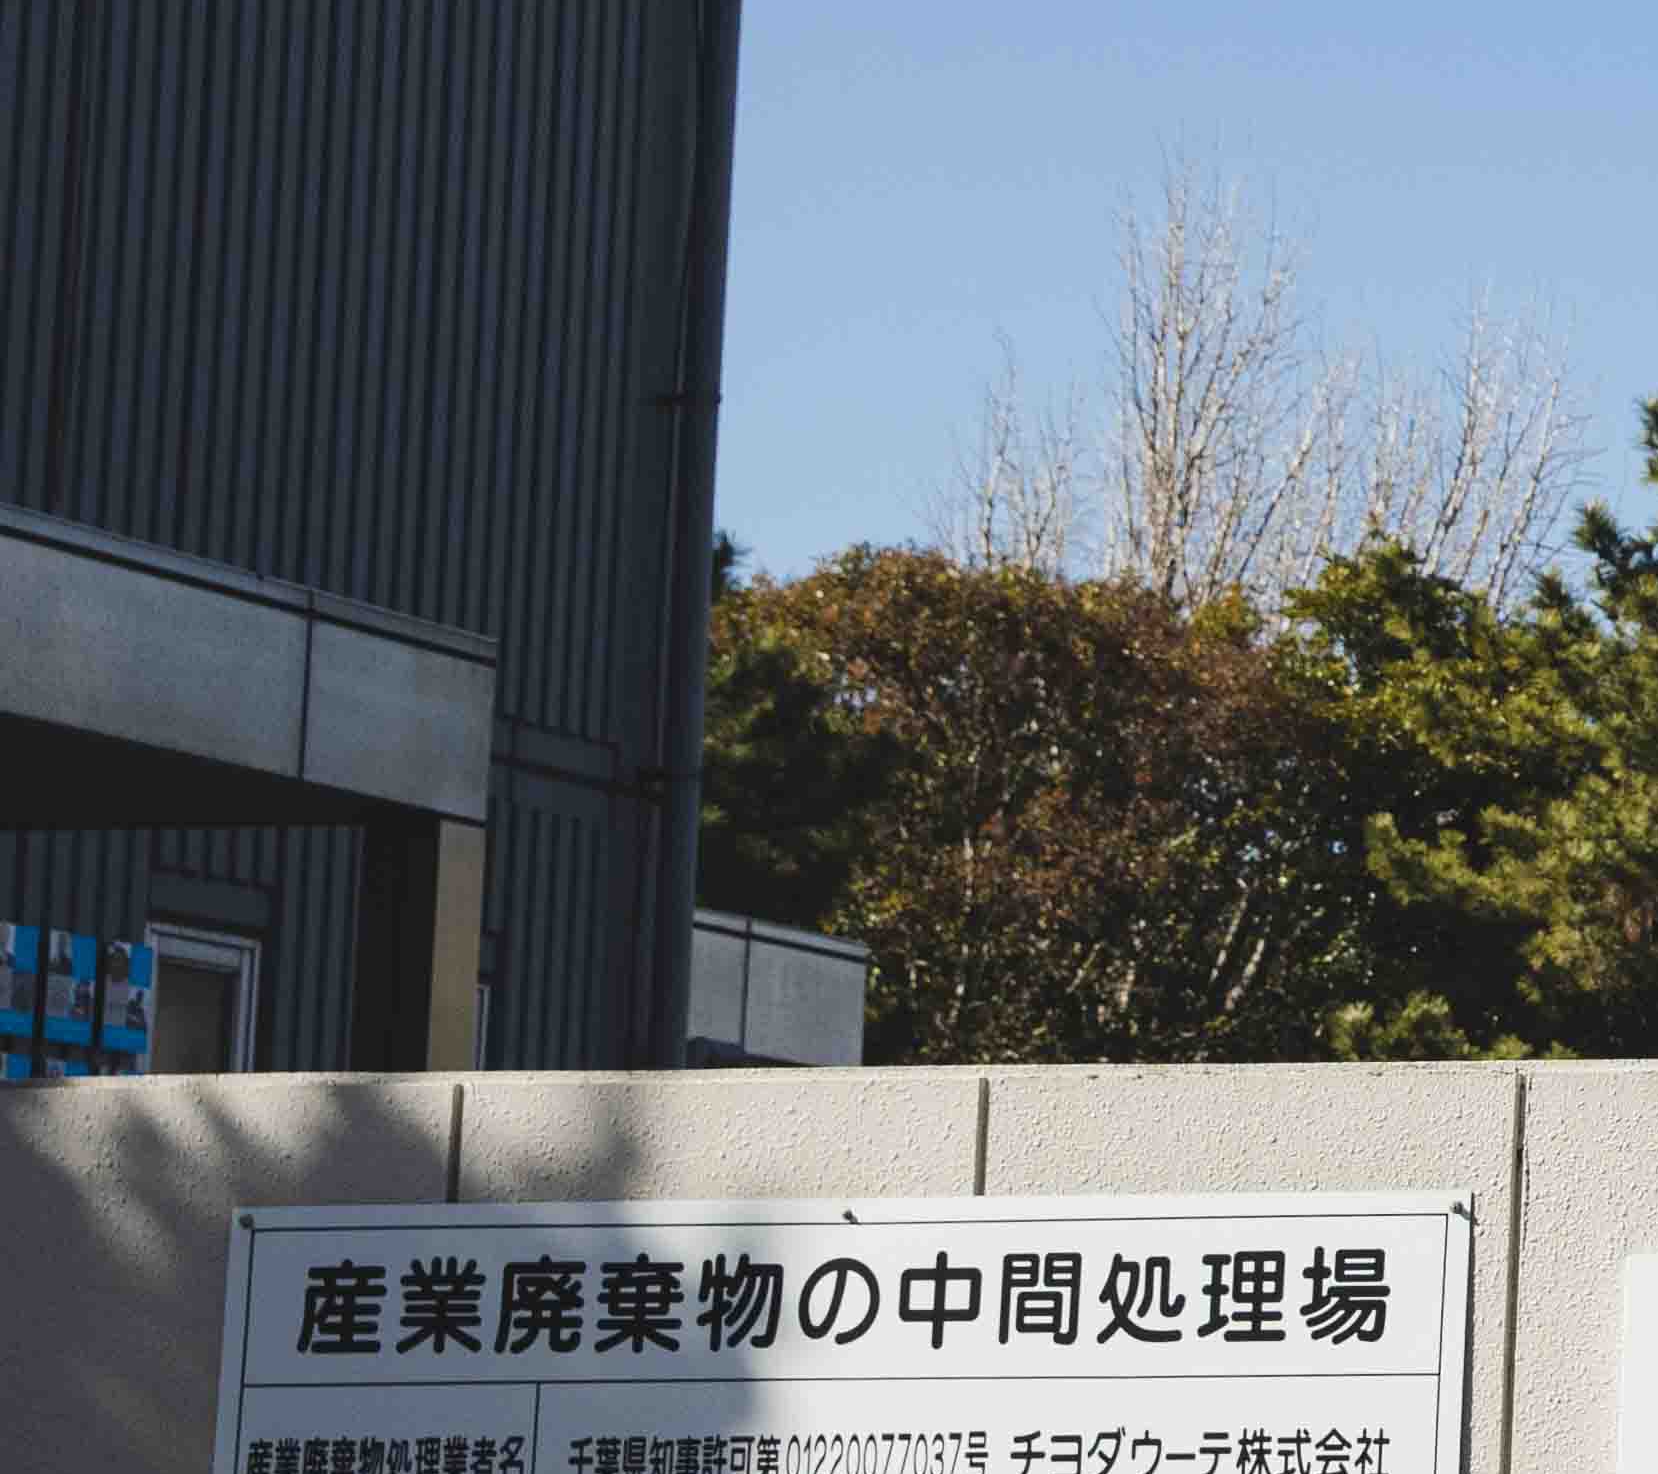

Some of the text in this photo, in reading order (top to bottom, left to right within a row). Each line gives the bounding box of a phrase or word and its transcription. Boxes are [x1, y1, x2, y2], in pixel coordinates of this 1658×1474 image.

[295, 1245, 1392, 1355] 産業廃棄物の中間処理場
